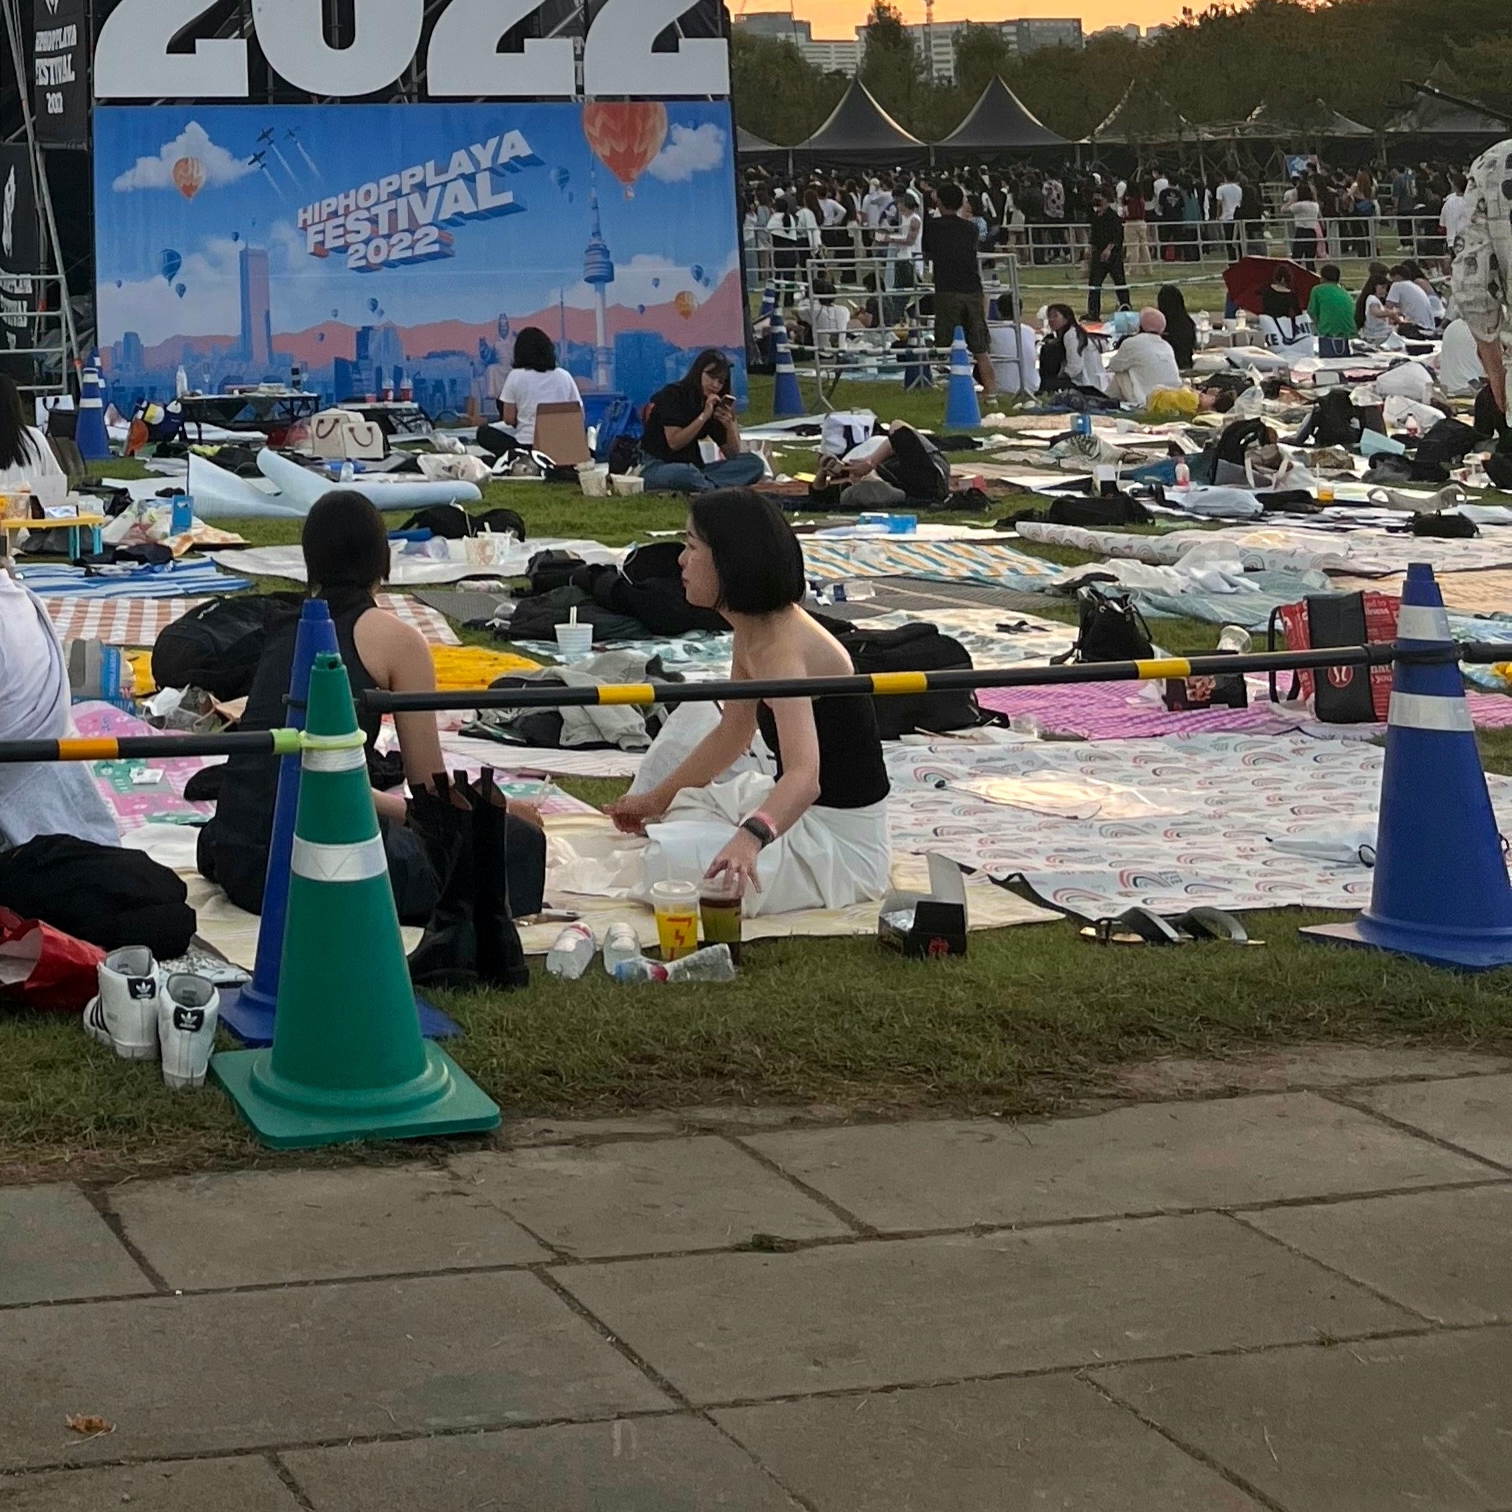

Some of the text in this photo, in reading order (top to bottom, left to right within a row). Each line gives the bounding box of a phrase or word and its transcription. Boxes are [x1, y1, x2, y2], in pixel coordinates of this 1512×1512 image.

[297, 129, 534, 229] HIPHOPPLAYA
[307, 170, 515, 255] FESTIVAL
[347, 225, 440, 270] 2022
